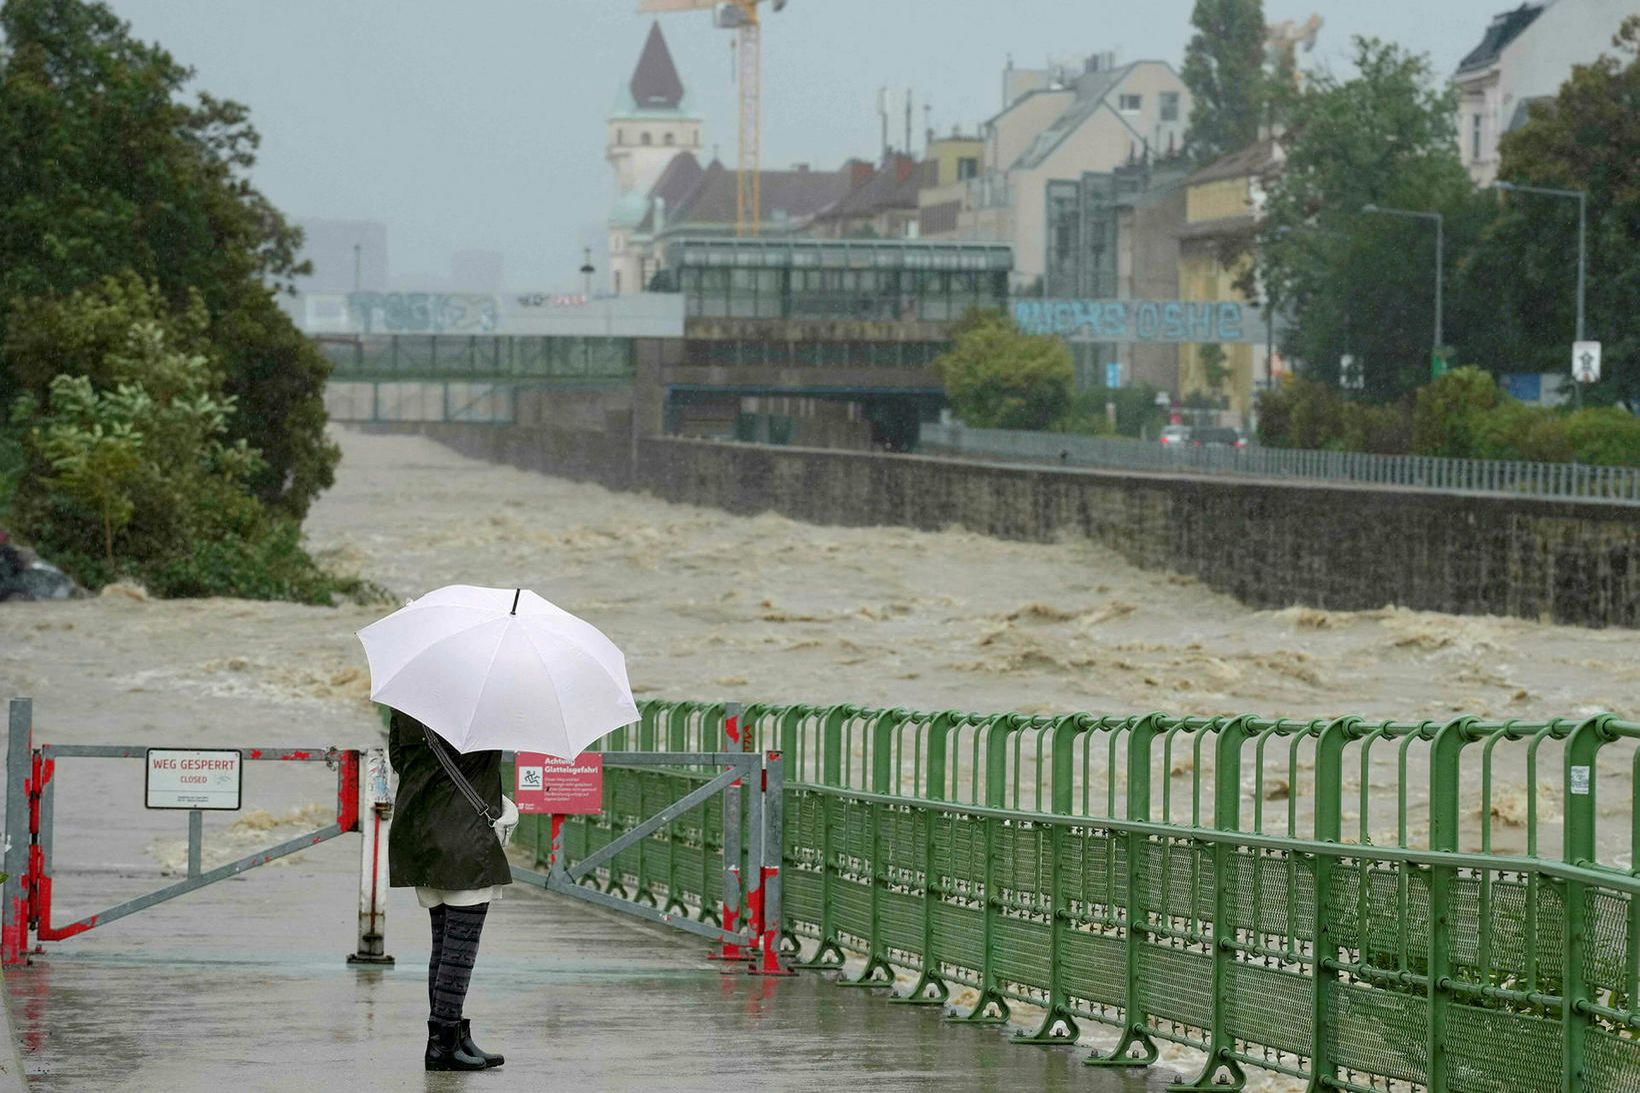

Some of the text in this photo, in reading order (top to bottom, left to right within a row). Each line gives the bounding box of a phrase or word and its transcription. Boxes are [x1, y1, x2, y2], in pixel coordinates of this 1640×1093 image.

[153, 759, 236, 770] WEG GESPERRT
[180, 775, 208, 784] CLOSED
